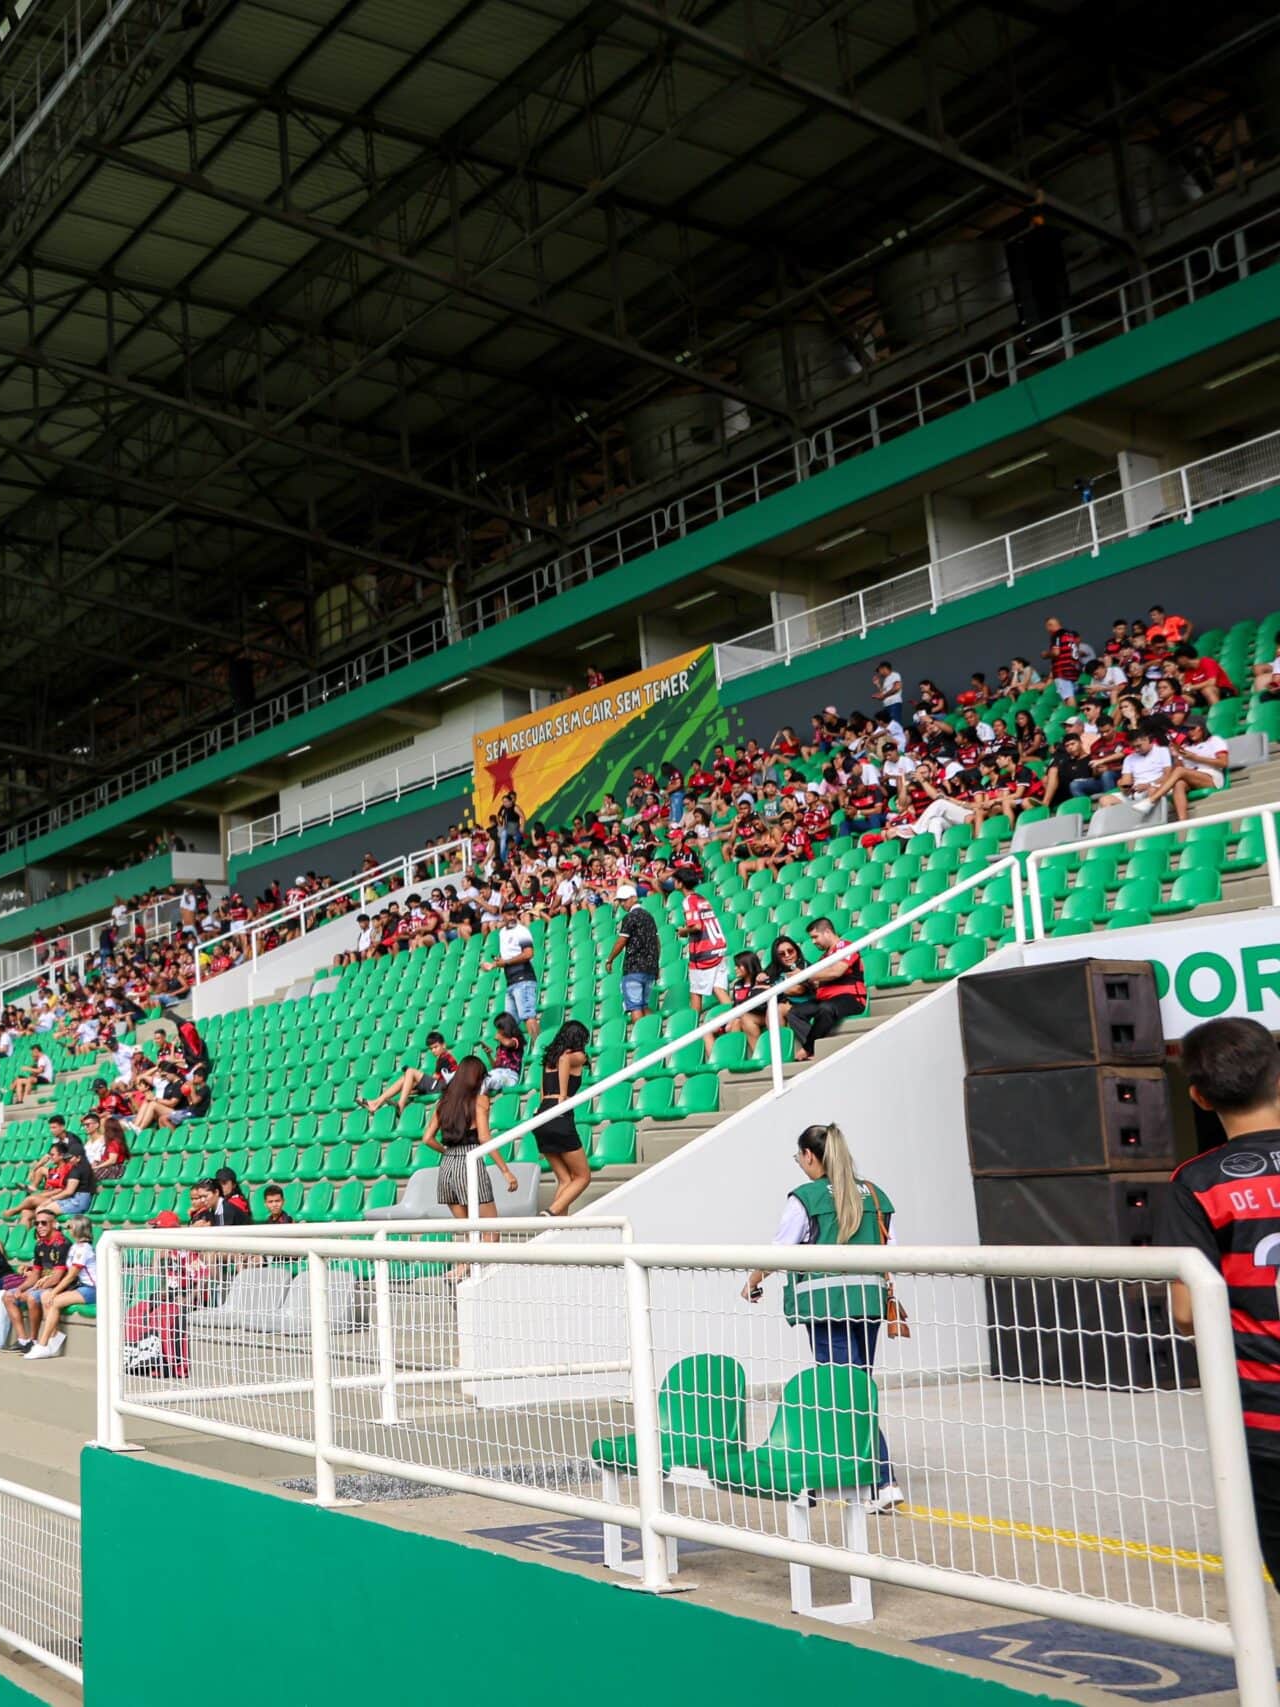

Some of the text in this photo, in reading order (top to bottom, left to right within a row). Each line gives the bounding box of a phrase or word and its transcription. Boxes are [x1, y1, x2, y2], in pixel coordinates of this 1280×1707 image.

[555, 710, 581, 737] SEM
[616, 688, 641, 715] SEM
[1229, 1189, 1260, 1211] DE
